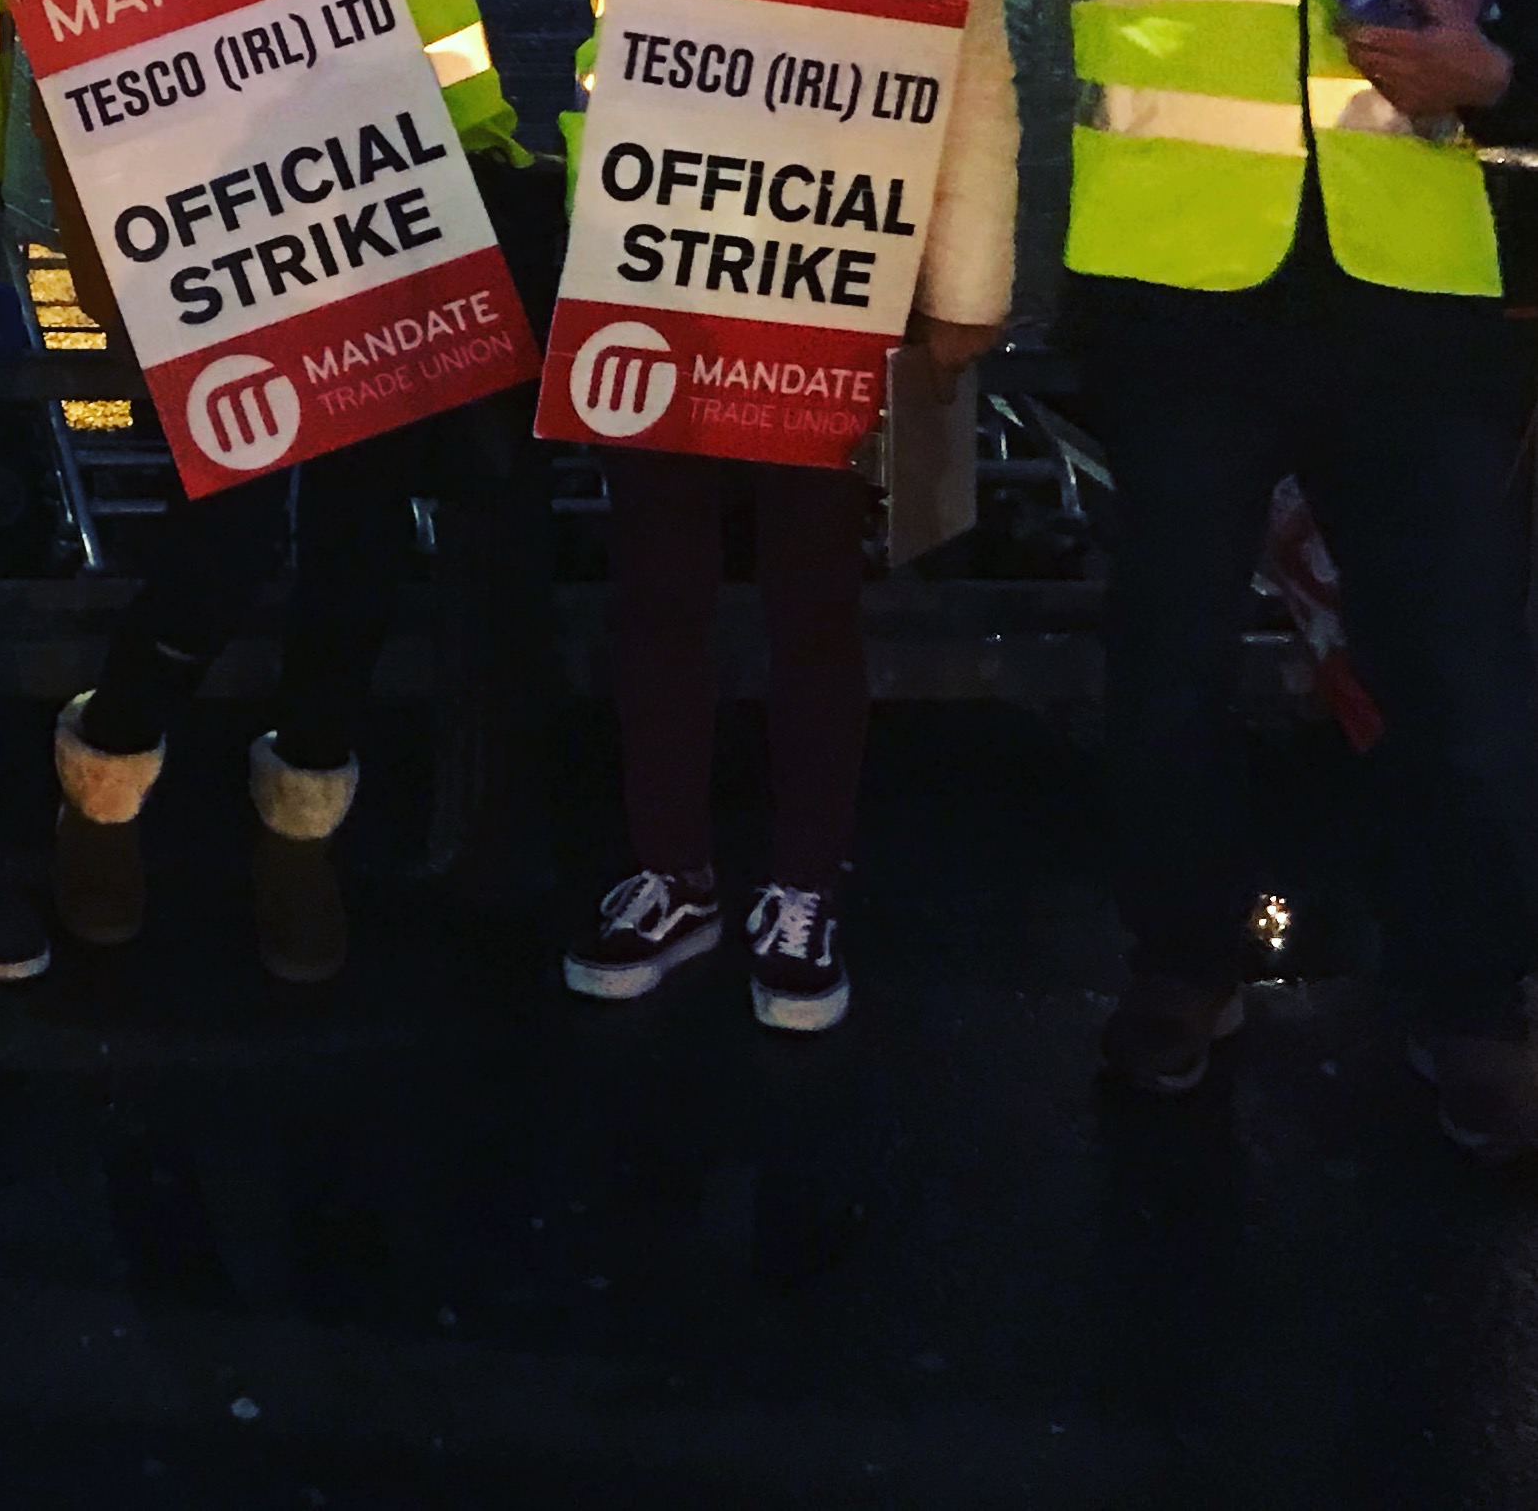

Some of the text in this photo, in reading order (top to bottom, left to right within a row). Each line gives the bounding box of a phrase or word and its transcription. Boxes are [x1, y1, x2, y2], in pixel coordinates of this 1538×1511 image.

[64, 50, 206, 134] TESCO
[213, 12, 318, 93] (IRL)
[622, 30, 940, 125] TESCO (IRL) LTD
[113, 110, 448, 263] OFFICIAL
[600, 141, 917, 237] OFFICIAL
[168, 188, 443, 327] STRIKE
[616, 222, 876, 309] STRIKE
[300, 289, 500, 386] MANDATE
[317, 333, 514, 418] TRADE UNION
[690, 355, 875, 405] MANDATE
[688, 394, 870, 438] TRADE UNION
